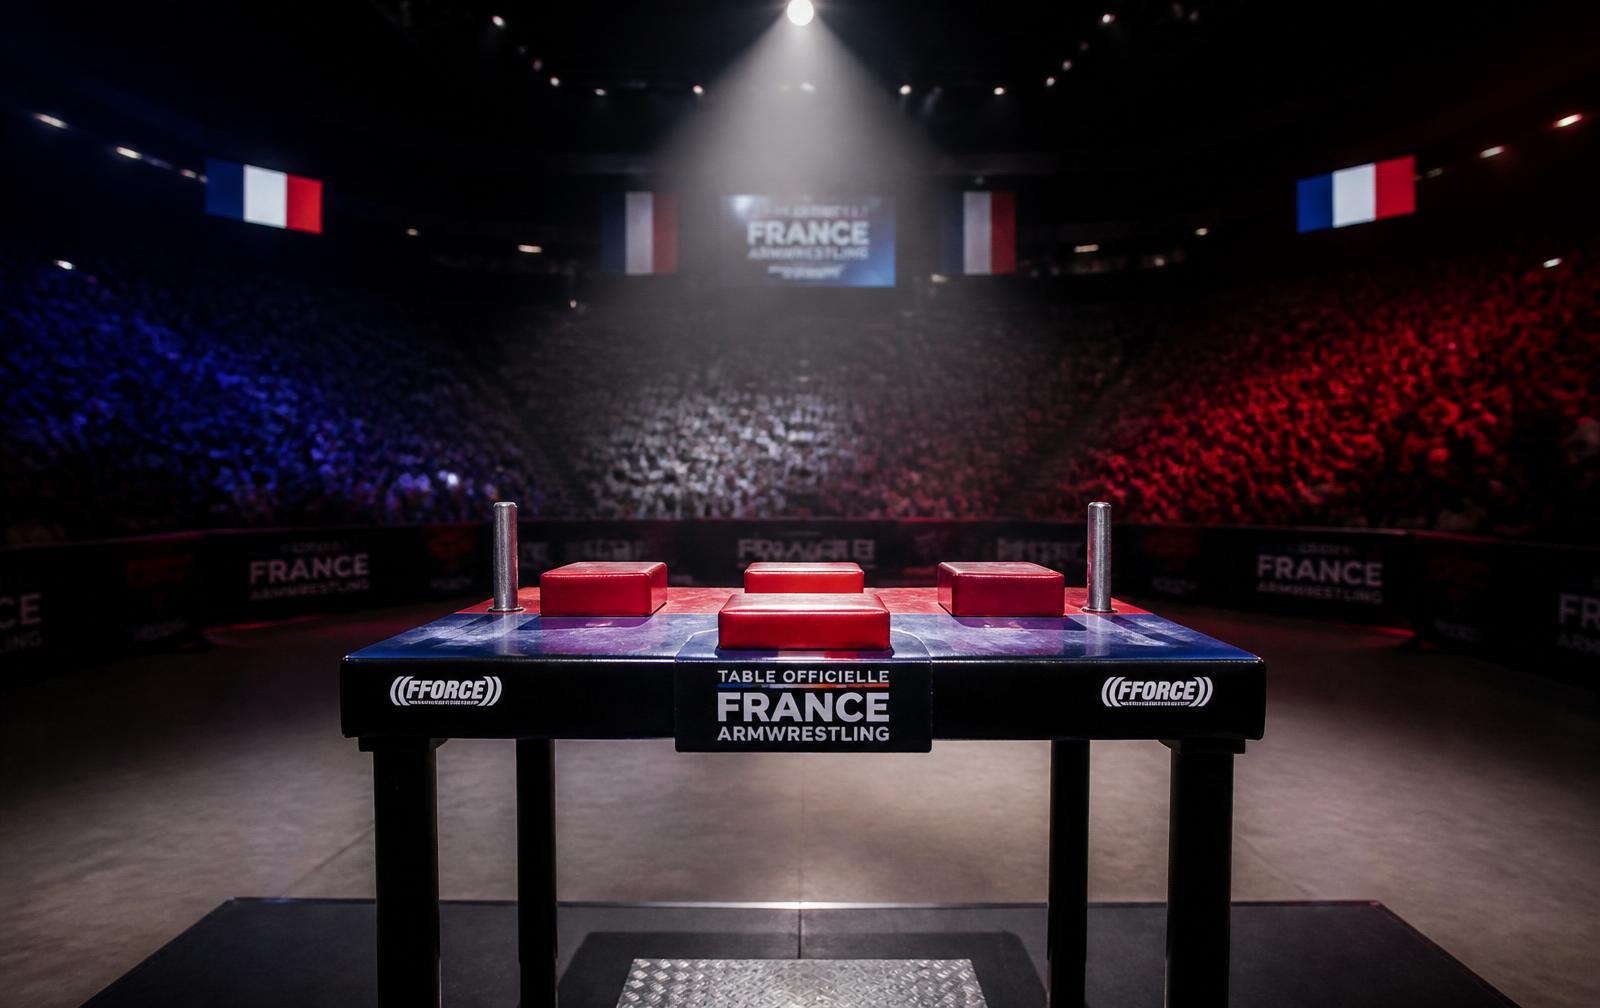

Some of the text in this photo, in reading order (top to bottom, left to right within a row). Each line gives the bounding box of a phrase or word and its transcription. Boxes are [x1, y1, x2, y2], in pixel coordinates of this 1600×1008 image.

[746, 220, 870, 245] FRANCE
[249, 552, 370, 585] FRANCE
[1256, 554, 1385, 588] FRANCE
[717, 670, 890, 683] TABLE OFFICIELLE
[406, 679, 487, 700] FFORCE
[1117, 680, 1198, 701] FFORCE
[717, 692, 890, 723] FRANCE
[717, 726, 890, 742] ARMWRESTLING
